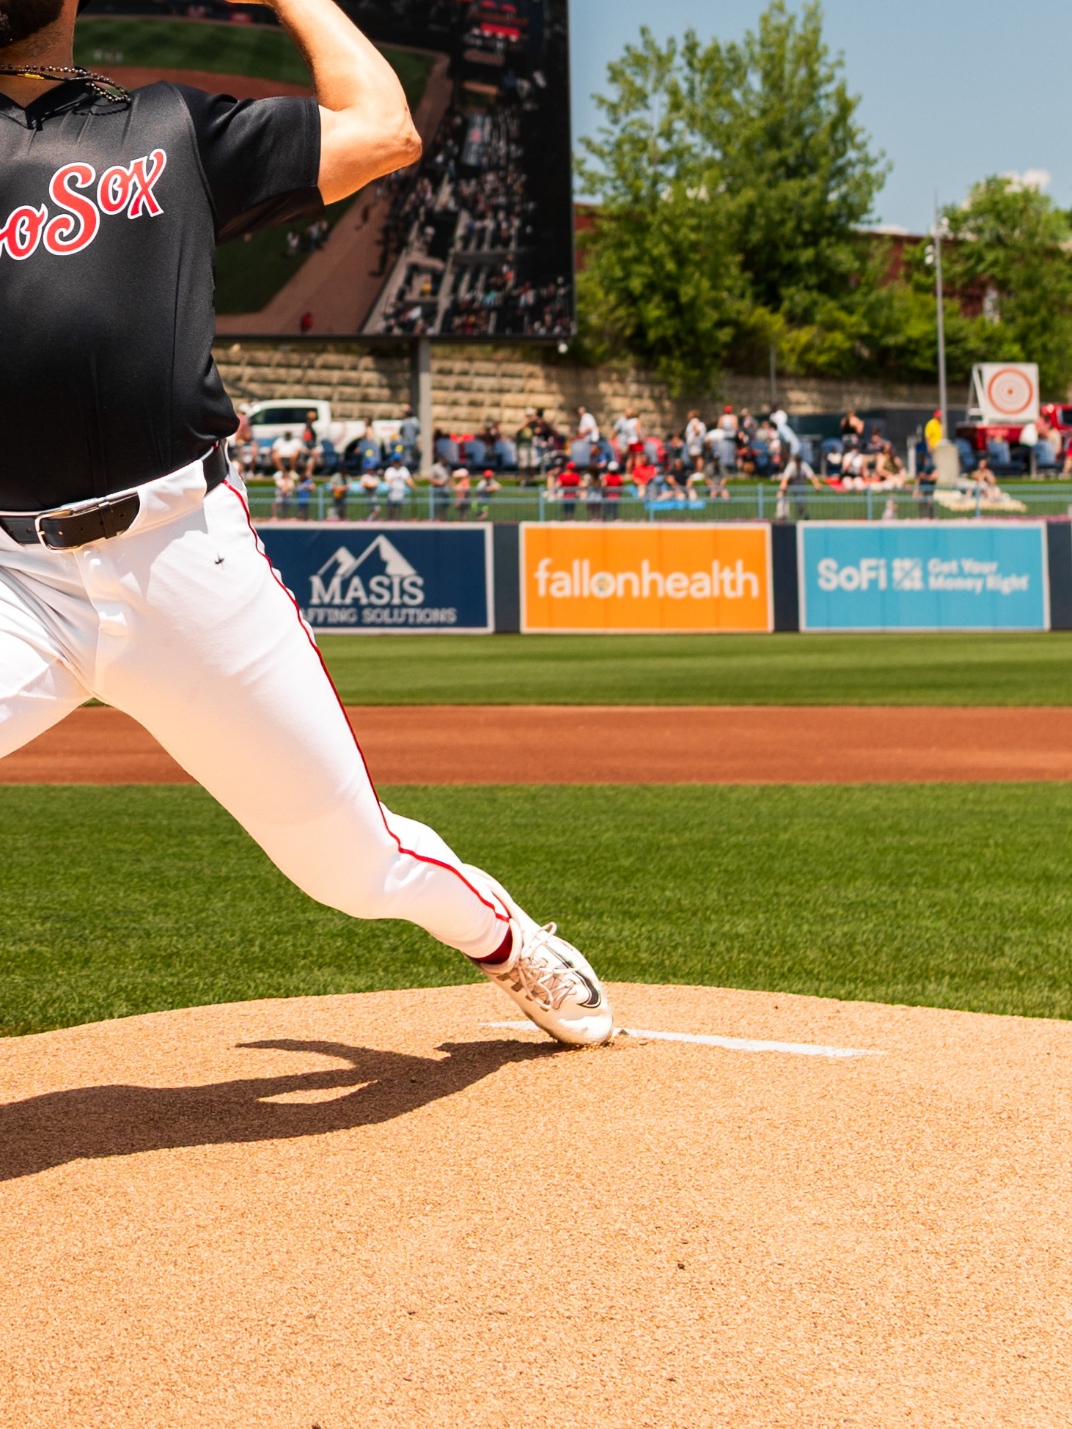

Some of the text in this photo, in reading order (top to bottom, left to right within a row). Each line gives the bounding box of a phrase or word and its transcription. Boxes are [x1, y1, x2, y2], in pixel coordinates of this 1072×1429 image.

[534, 558, 759, 599] fallonhealth
[817, 558, 887, 591] SoFi
[928, 574, 984, 596] Money
[309, 575, 425, 606] MASIS
[303, 607, 457, 624] FFING SOLUTIONS
